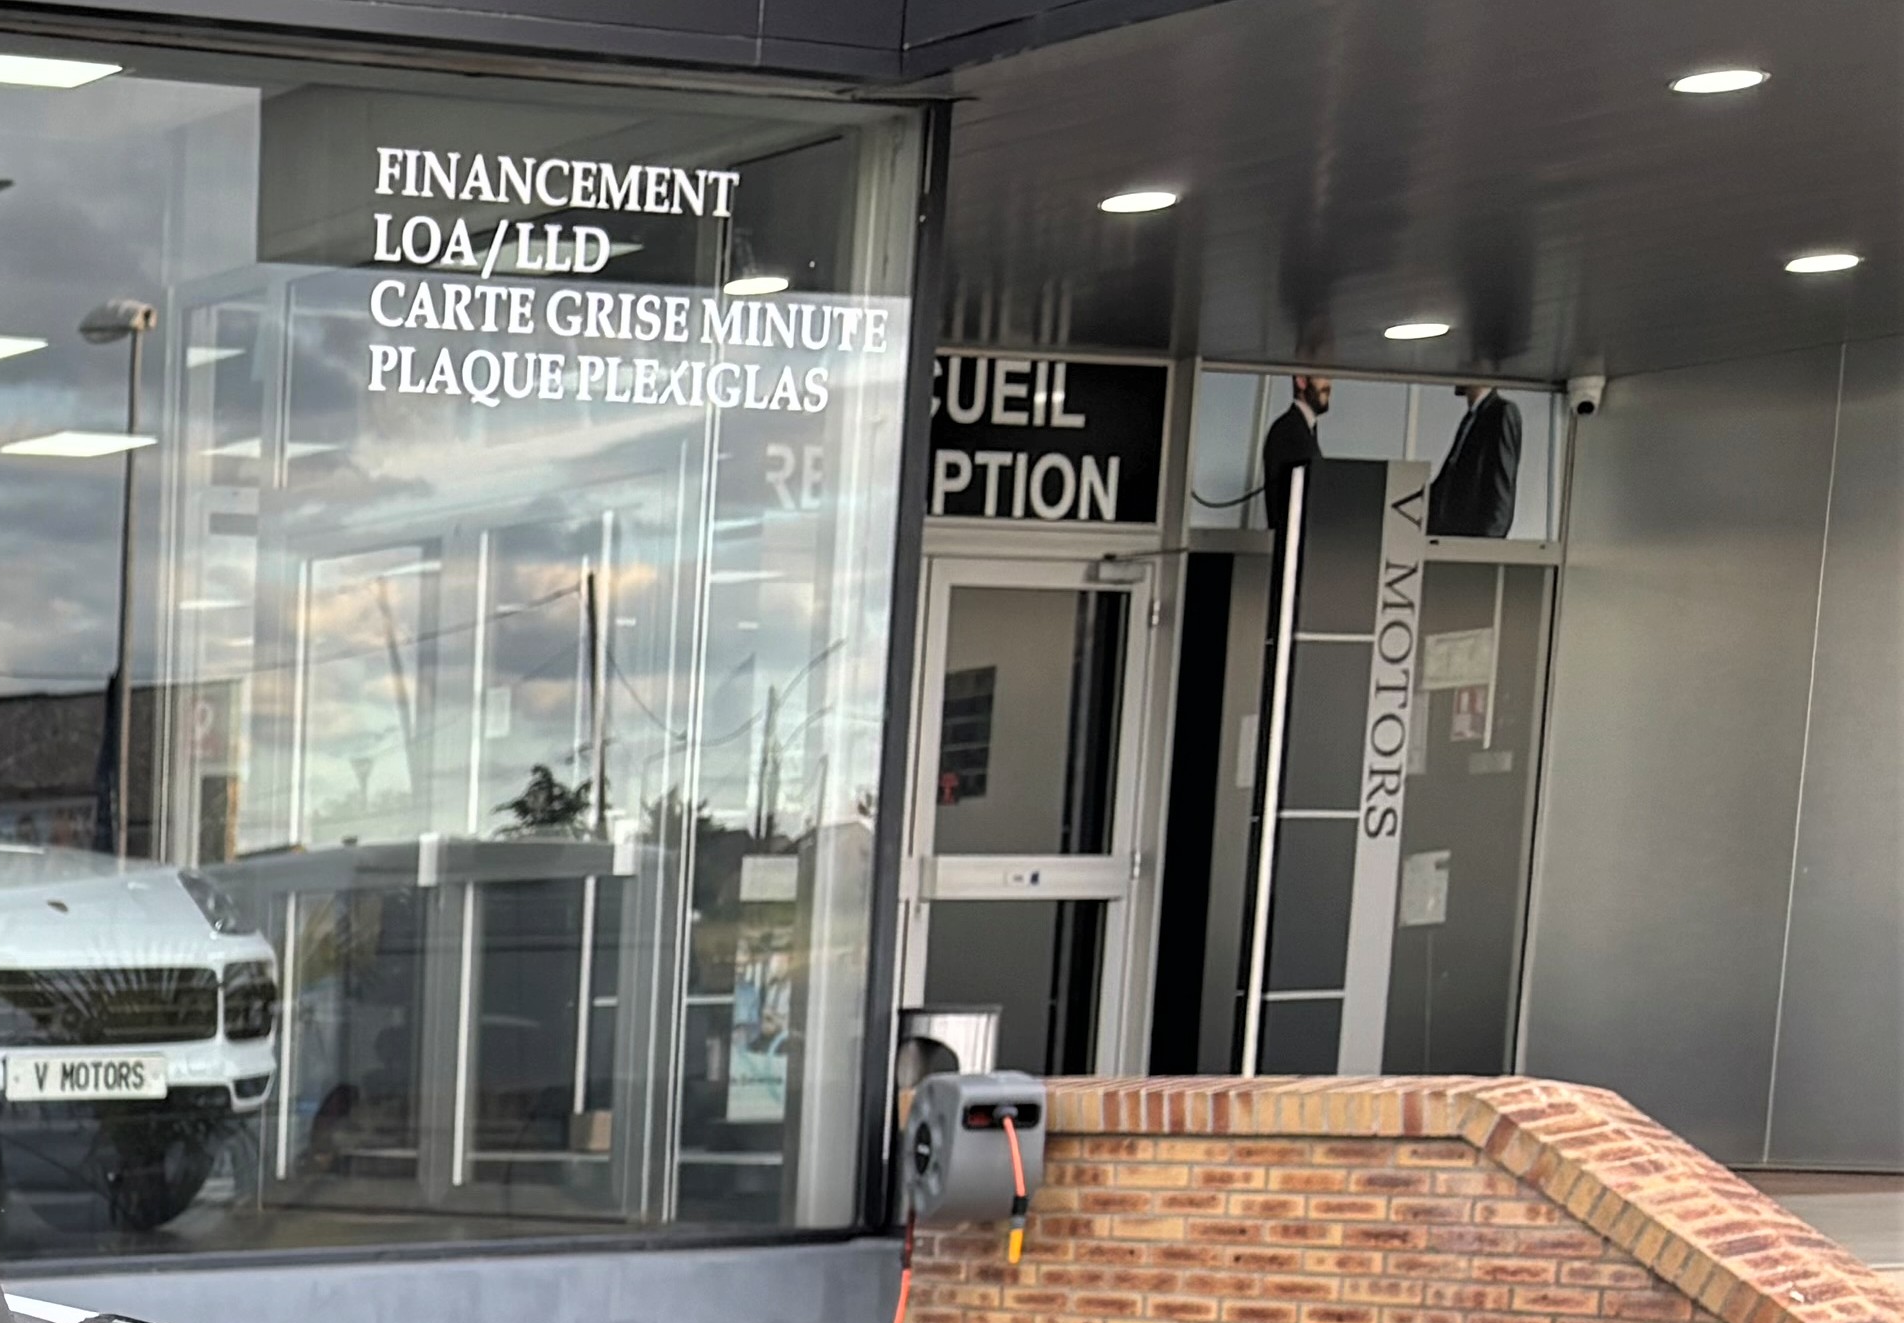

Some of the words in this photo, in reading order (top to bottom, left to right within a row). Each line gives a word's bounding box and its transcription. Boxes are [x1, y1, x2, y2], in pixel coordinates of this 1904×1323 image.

[375, 147, 740, 218] FINANCEMENT
[373, 213, 611, 280] LOA/LLD
[371, 279, 535, 335] CARTE
[546, 289, 690, 343] GRISE
[700, 300, 889, 353] MINUTE
[368, 344, 565, 406] PLAQUE
[576, 355, 830, 413] PLEXIGLAS
[1390, 487, 1425, 531] V
[1363, 560, 1419, 840] MOTORS
[34, 1062, 48, 1093] V
[60, 1061, 145, 1092] MOTORS
